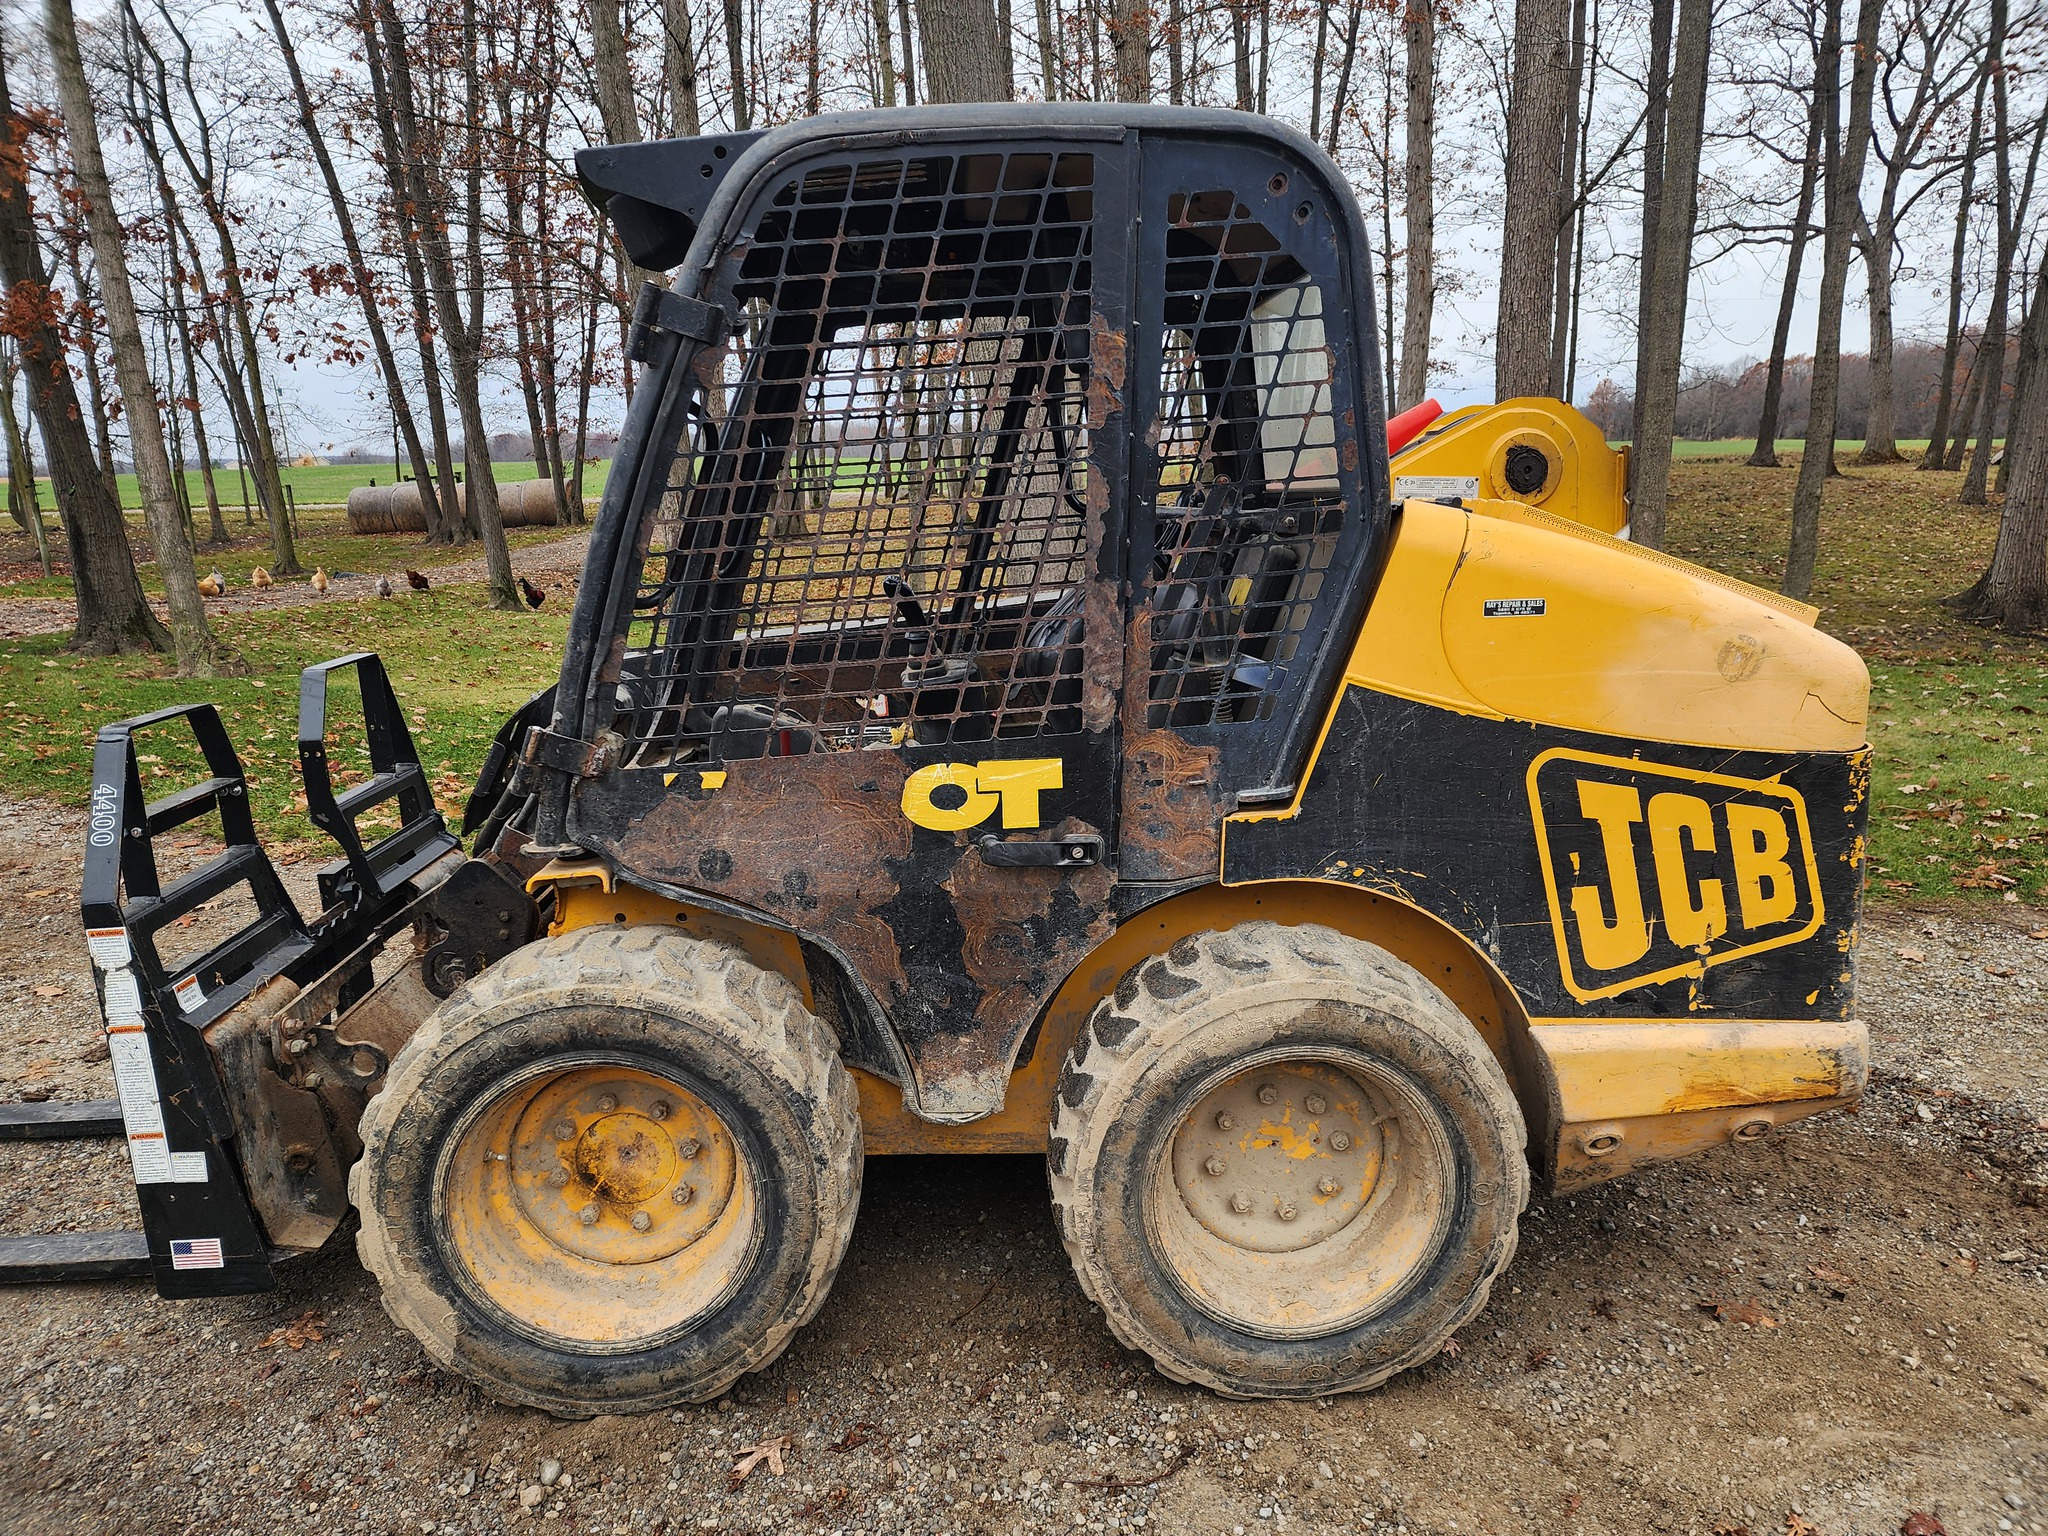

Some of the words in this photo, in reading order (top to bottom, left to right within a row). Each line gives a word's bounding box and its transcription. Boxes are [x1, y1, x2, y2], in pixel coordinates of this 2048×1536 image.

[1502, 600, 1521, 608] REPAIR
[90, 783, 117, 847] 4400
[1569, 779, 1797, 970] JCB
[114, 1026, 144, 1034] WARNING
